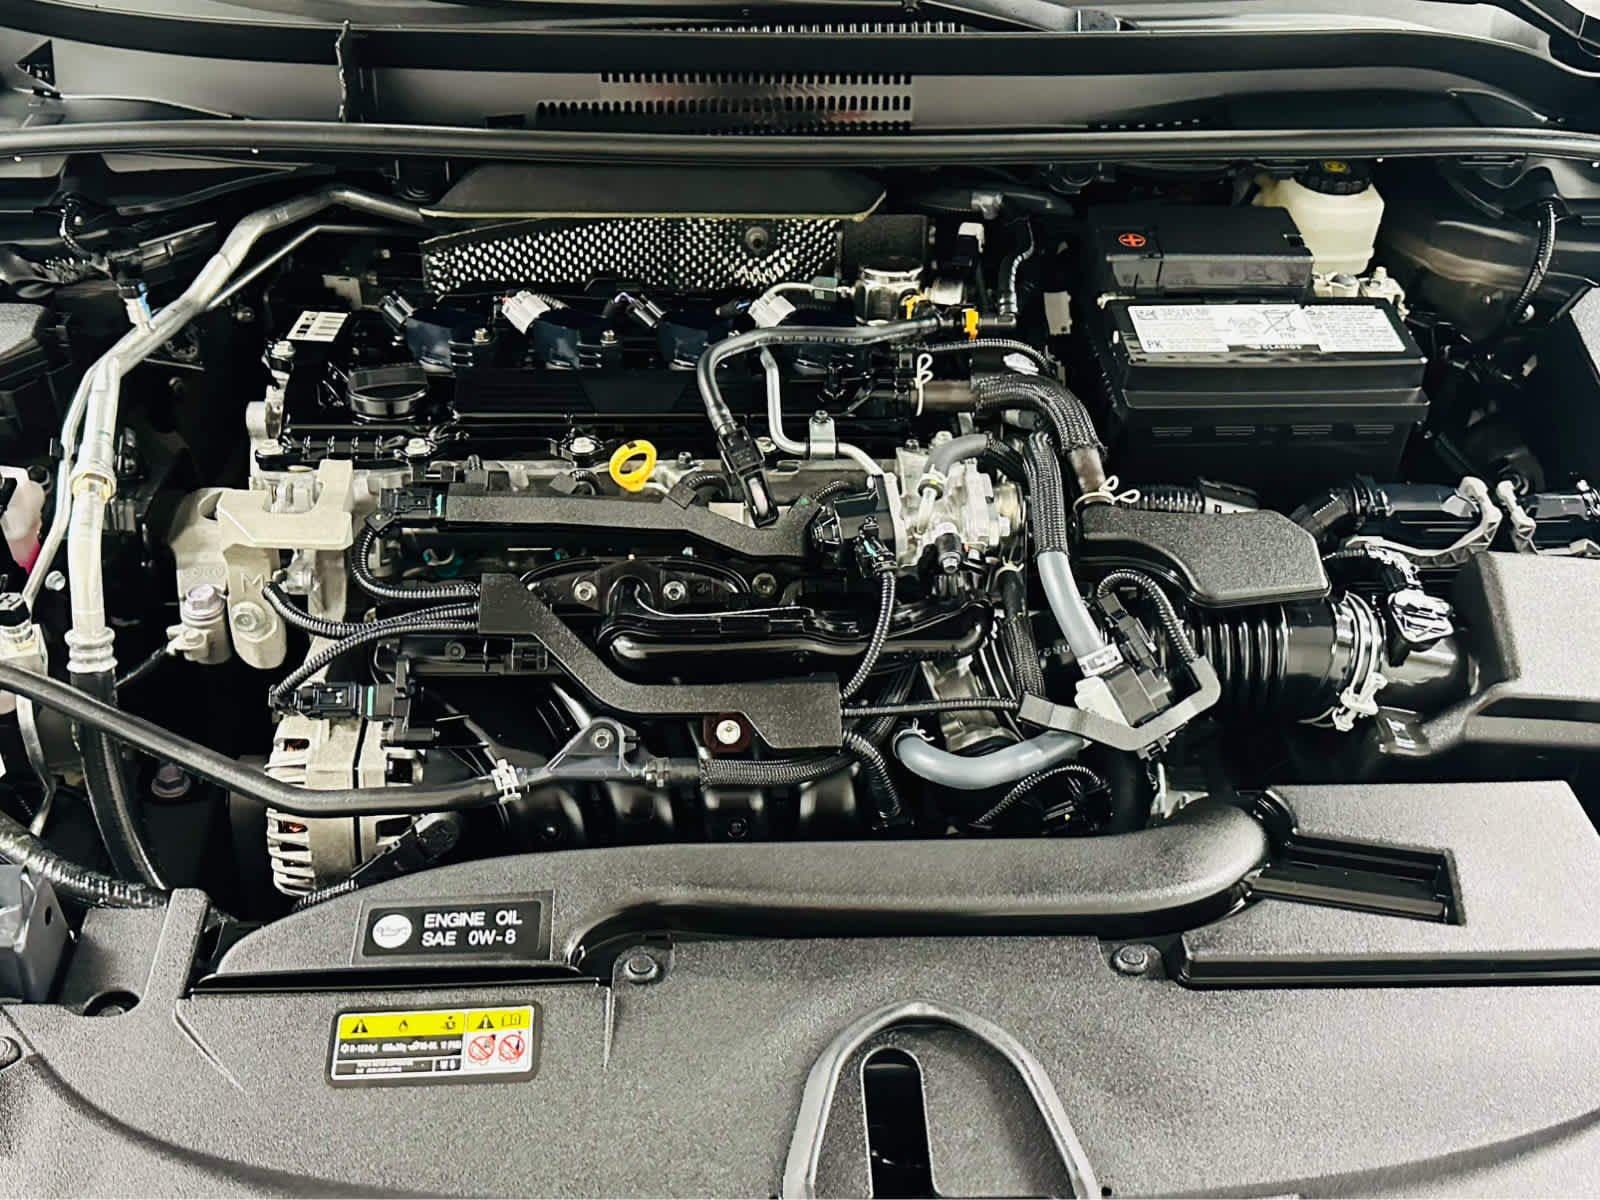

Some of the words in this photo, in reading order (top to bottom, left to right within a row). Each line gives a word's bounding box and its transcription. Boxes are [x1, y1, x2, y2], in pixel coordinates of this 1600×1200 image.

[241, 574, 265, 593] M
[423, 911, 486, 928] ENGINE
[495, 910, 523, 926] OIL
[421, 930, 457, 947] SAE
[468, 928, 517, 945] 0W-8
